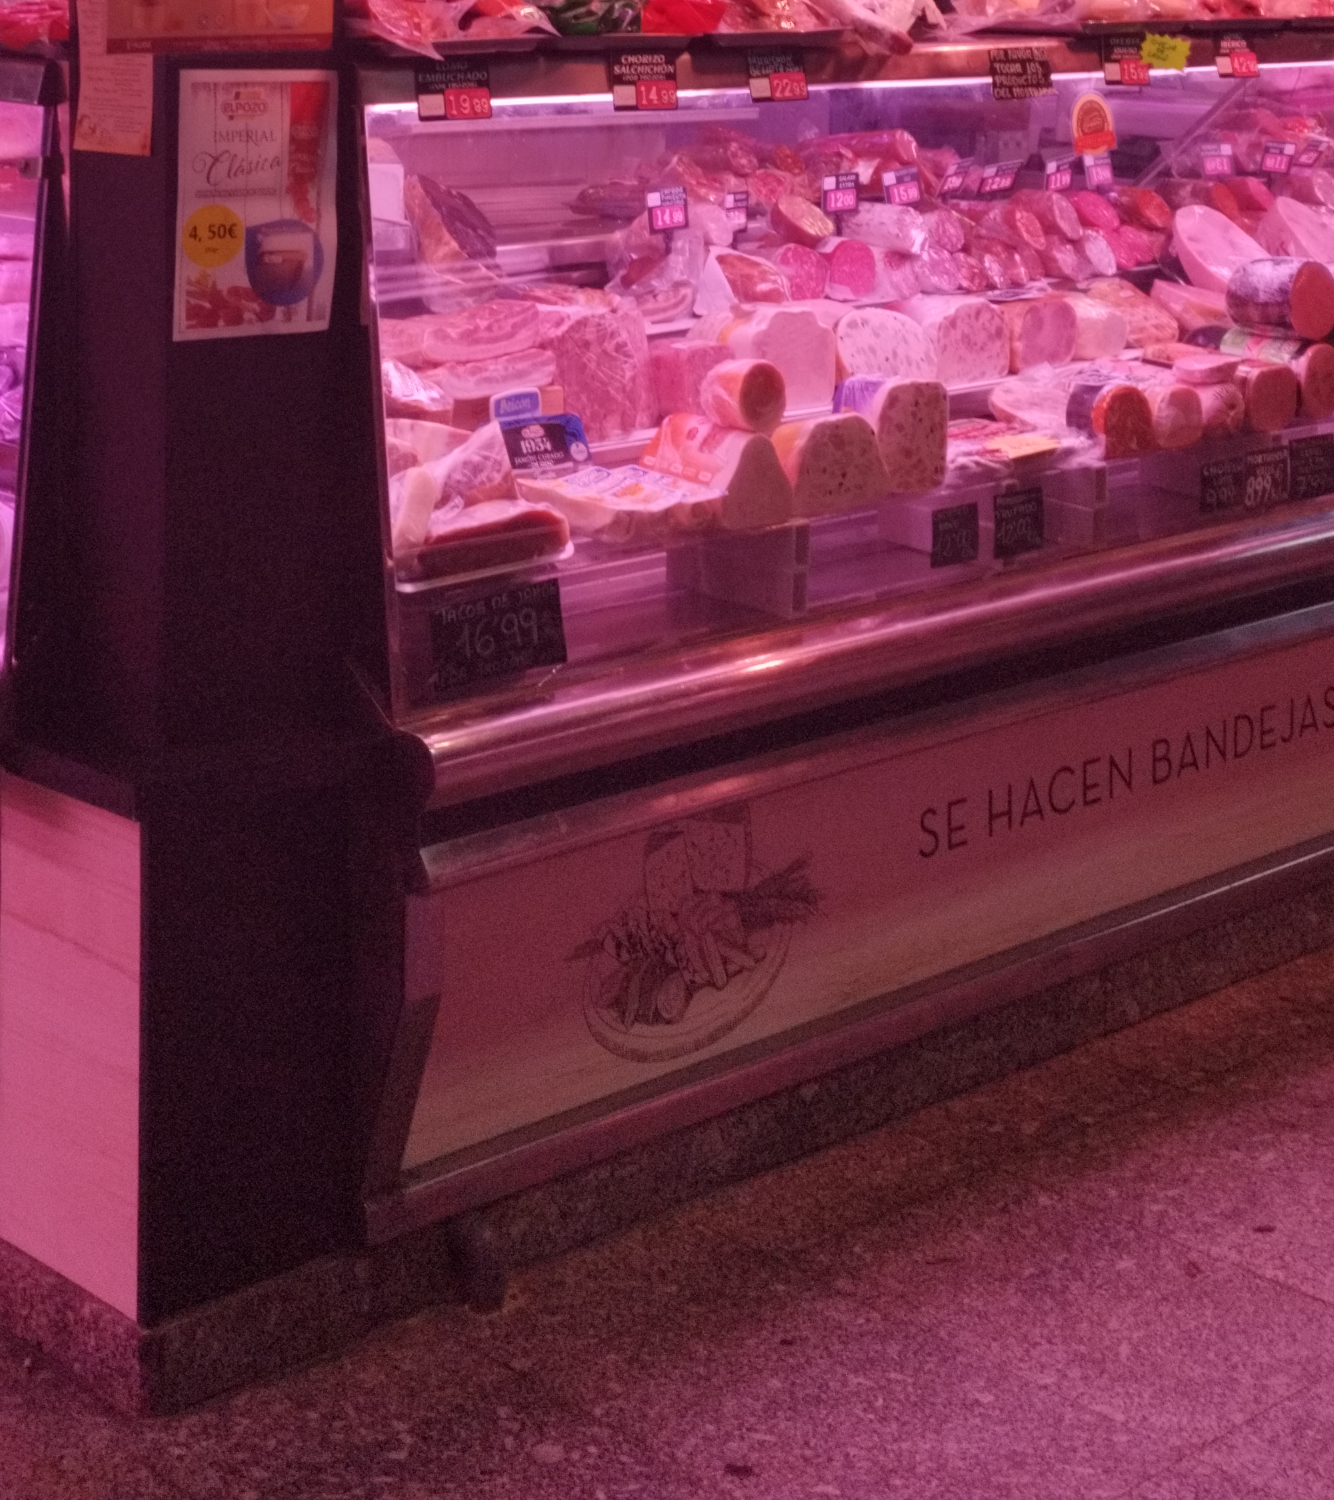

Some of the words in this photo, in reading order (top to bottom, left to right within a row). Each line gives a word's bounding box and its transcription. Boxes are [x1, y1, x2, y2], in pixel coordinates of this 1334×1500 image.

[621, 54, 666, 64] CHORIZO
[613, 63, 675, 76] SALCHICHÓN
[213, 129, 278, 145] IMPERIAL
[191, 150, 281, 187] Clásica
[435, 600, 487, 625] TACOS
[917, 797, 971, 861] SE
[985, 747, 1135, 838] HACEN
